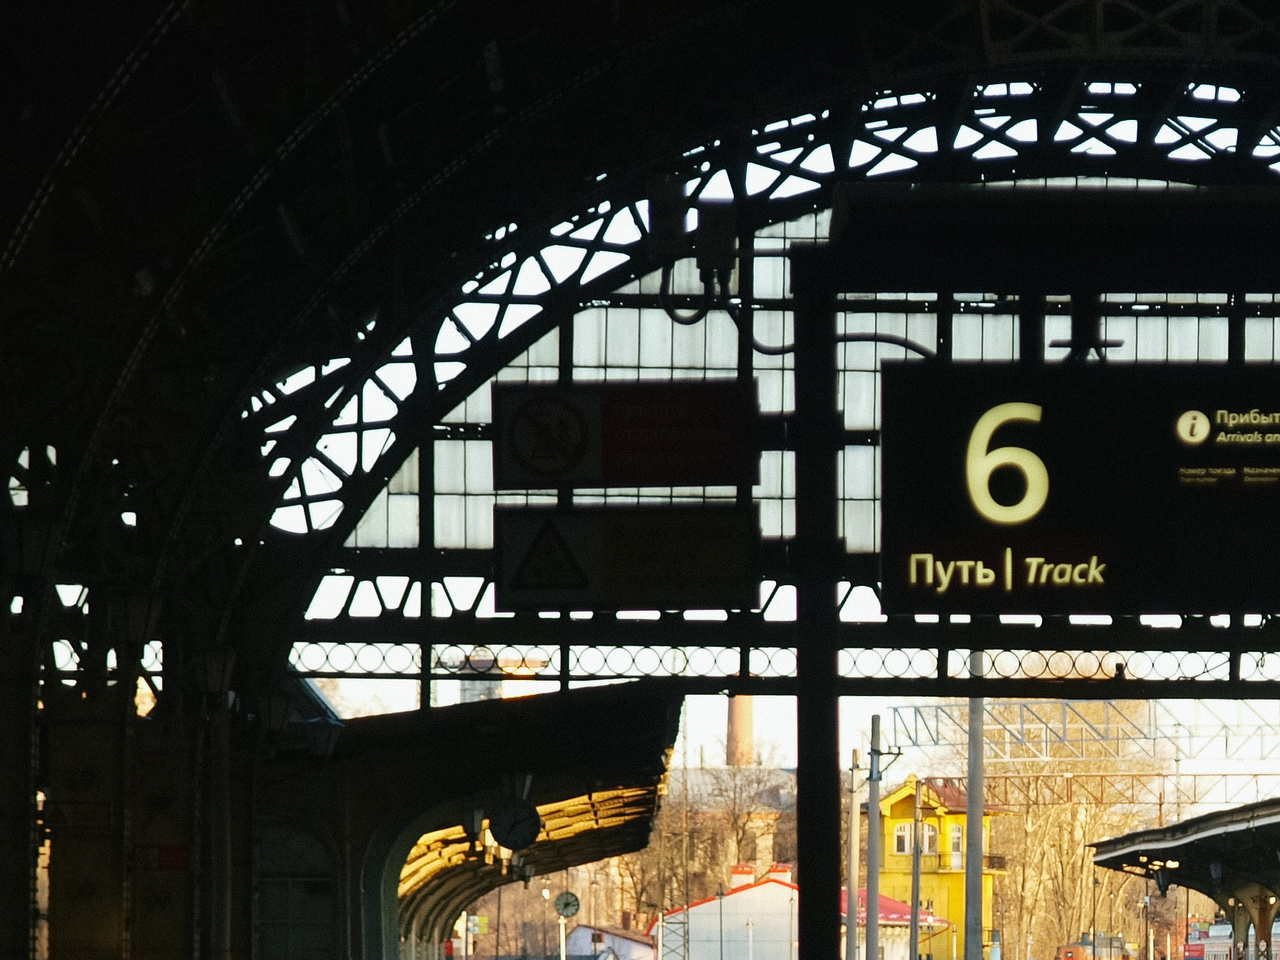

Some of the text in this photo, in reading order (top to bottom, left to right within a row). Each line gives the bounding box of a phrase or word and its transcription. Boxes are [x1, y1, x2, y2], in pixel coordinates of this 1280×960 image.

[1216, 431, 1262, 443] Arrivals
[966, 402, 1050, 522] 6
[910, 553, 995, 591] Путь
[1025, 556, 1106, 583] Track
